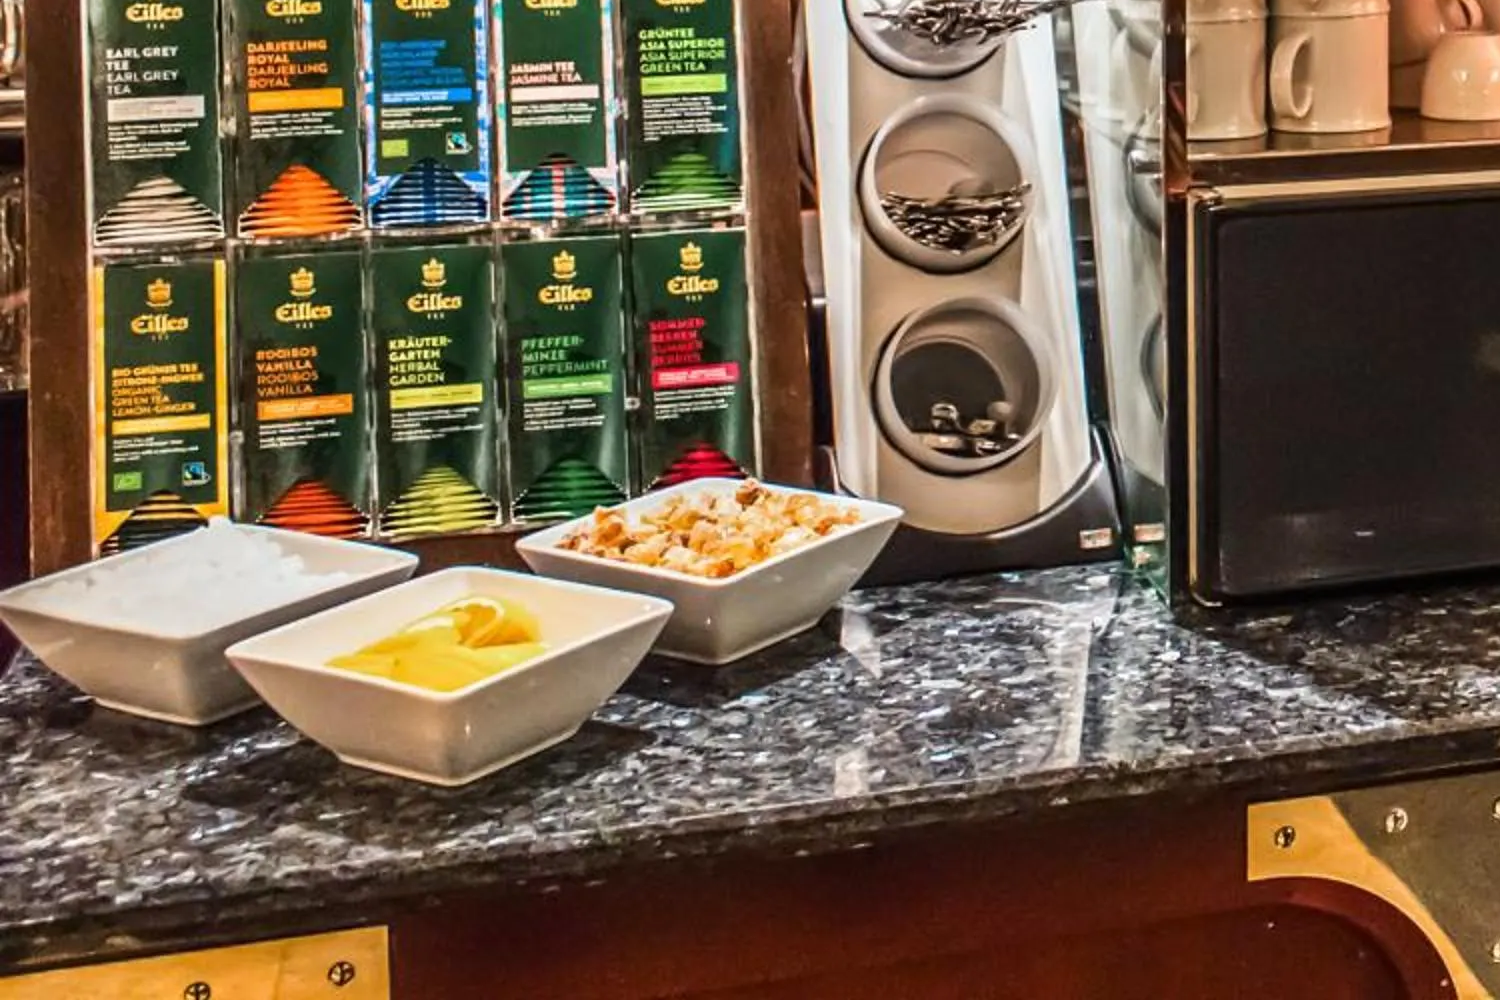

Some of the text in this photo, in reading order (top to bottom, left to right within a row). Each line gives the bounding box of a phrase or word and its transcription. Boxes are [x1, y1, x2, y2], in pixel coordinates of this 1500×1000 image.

[639, 26, 695, 39] GRÜNTEE
[247, 39, 328, 53] DARJEELING
[639, 37, 726, 51] ASIA SUPERIOR
[105, 45, 179, 59] EARL GREY
[247, 53, 290, 65] ROYAL
[639, 49, 726, 62] ASIA SUPERIOR
[105, 60, 129, 71] TEE
[247, 62, 328, 77] DARJEELING
[510, 61, 576, 74] JASMIN TEE
[640, 60, 706, 73] GREEN TEA
[107, 69, 179, 83] EARL GREY
[247, 77, 291, 89] ROYAL
[510, 72, 582, 85] JASMINE TEA
[106, 84, 131, 95] TEA
[389, 336, 452, 350] KRÄUTER-
[522, 335, 584, 350] PFEFFER-
[256, 346, 318, 361] ROOIBOS
[389, 349, 441, 362] GARTEN
[523, 349, 567, 363] MINZE
[256, 359, 313, 373] VANILLA
[389, 361, 440, 374] HERBAL
[523, 359, 608, 376] PEPPERMINT
[257, 370, 319, 385] ROOIBOS
[389, 372, 445, 386] GARDEN
[258, 383, 313, 397] VANILLA
[112, 395, 170, 407] GREEN TEA
